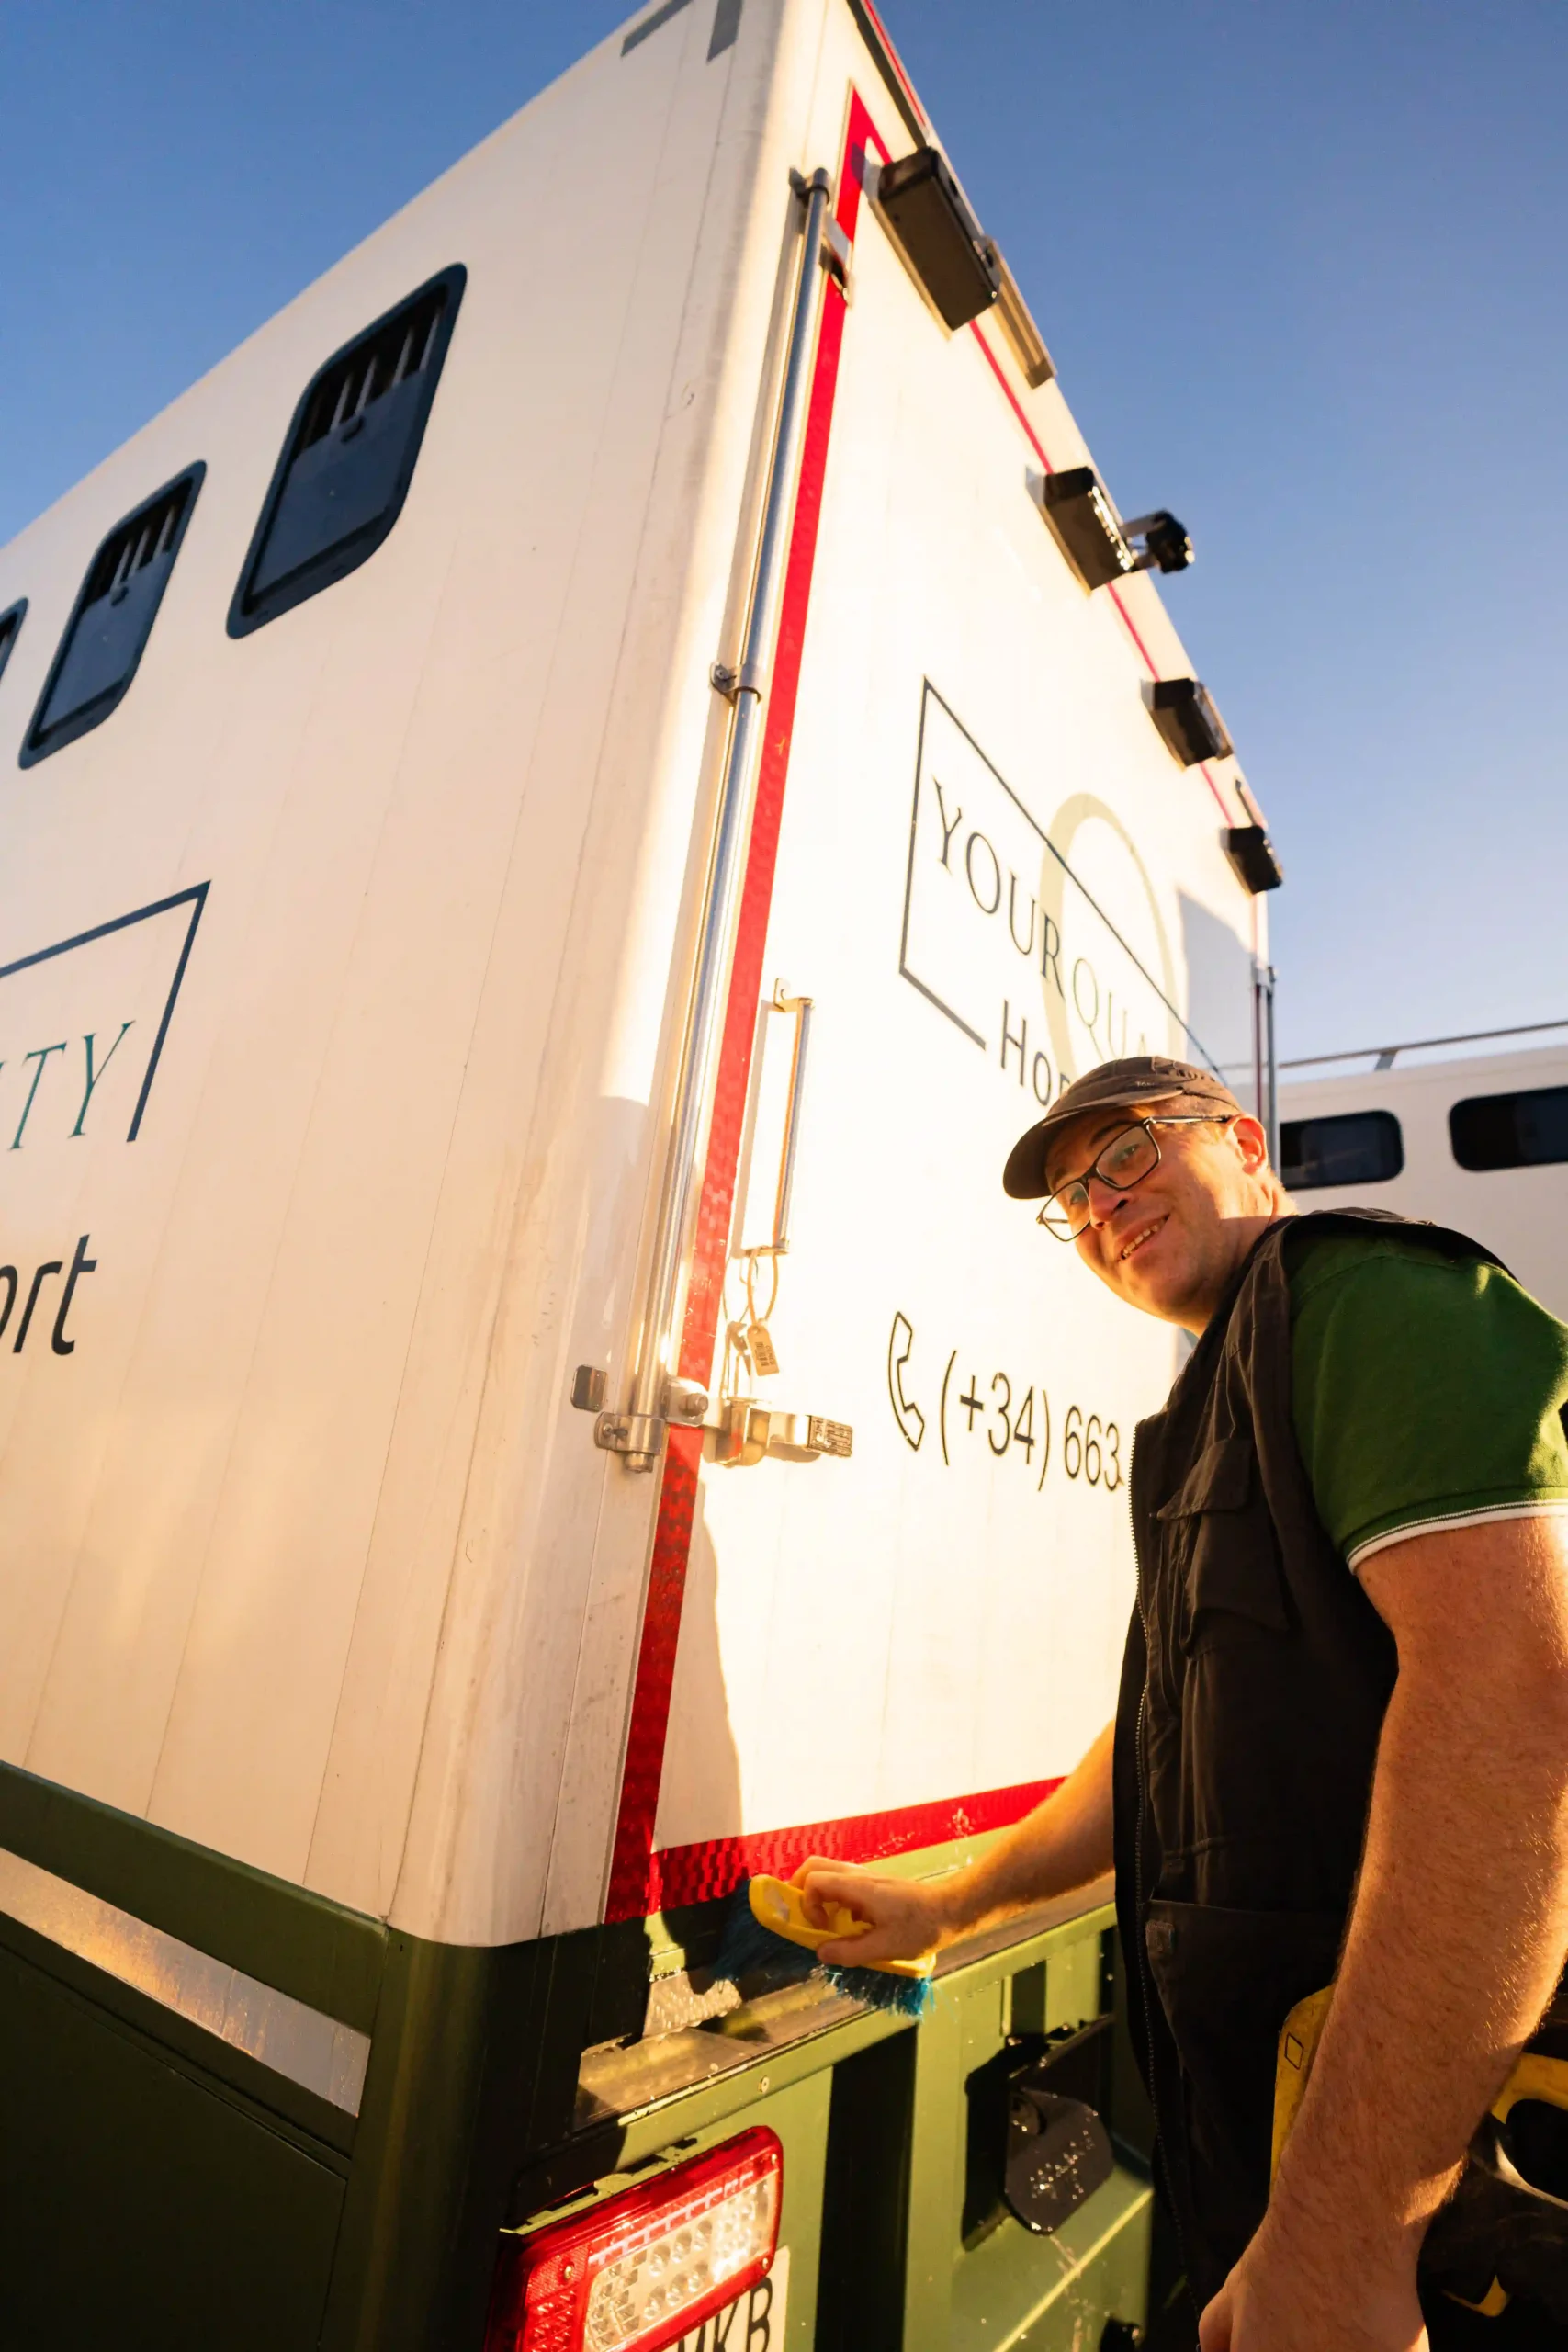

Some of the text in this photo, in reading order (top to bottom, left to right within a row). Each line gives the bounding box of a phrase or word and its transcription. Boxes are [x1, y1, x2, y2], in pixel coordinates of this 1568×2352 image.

[0, 1020, 136, 1152] TY
[941, 1350, 1121, 1491] (+34) 663
[677, 2276, 773, 2352] KB
